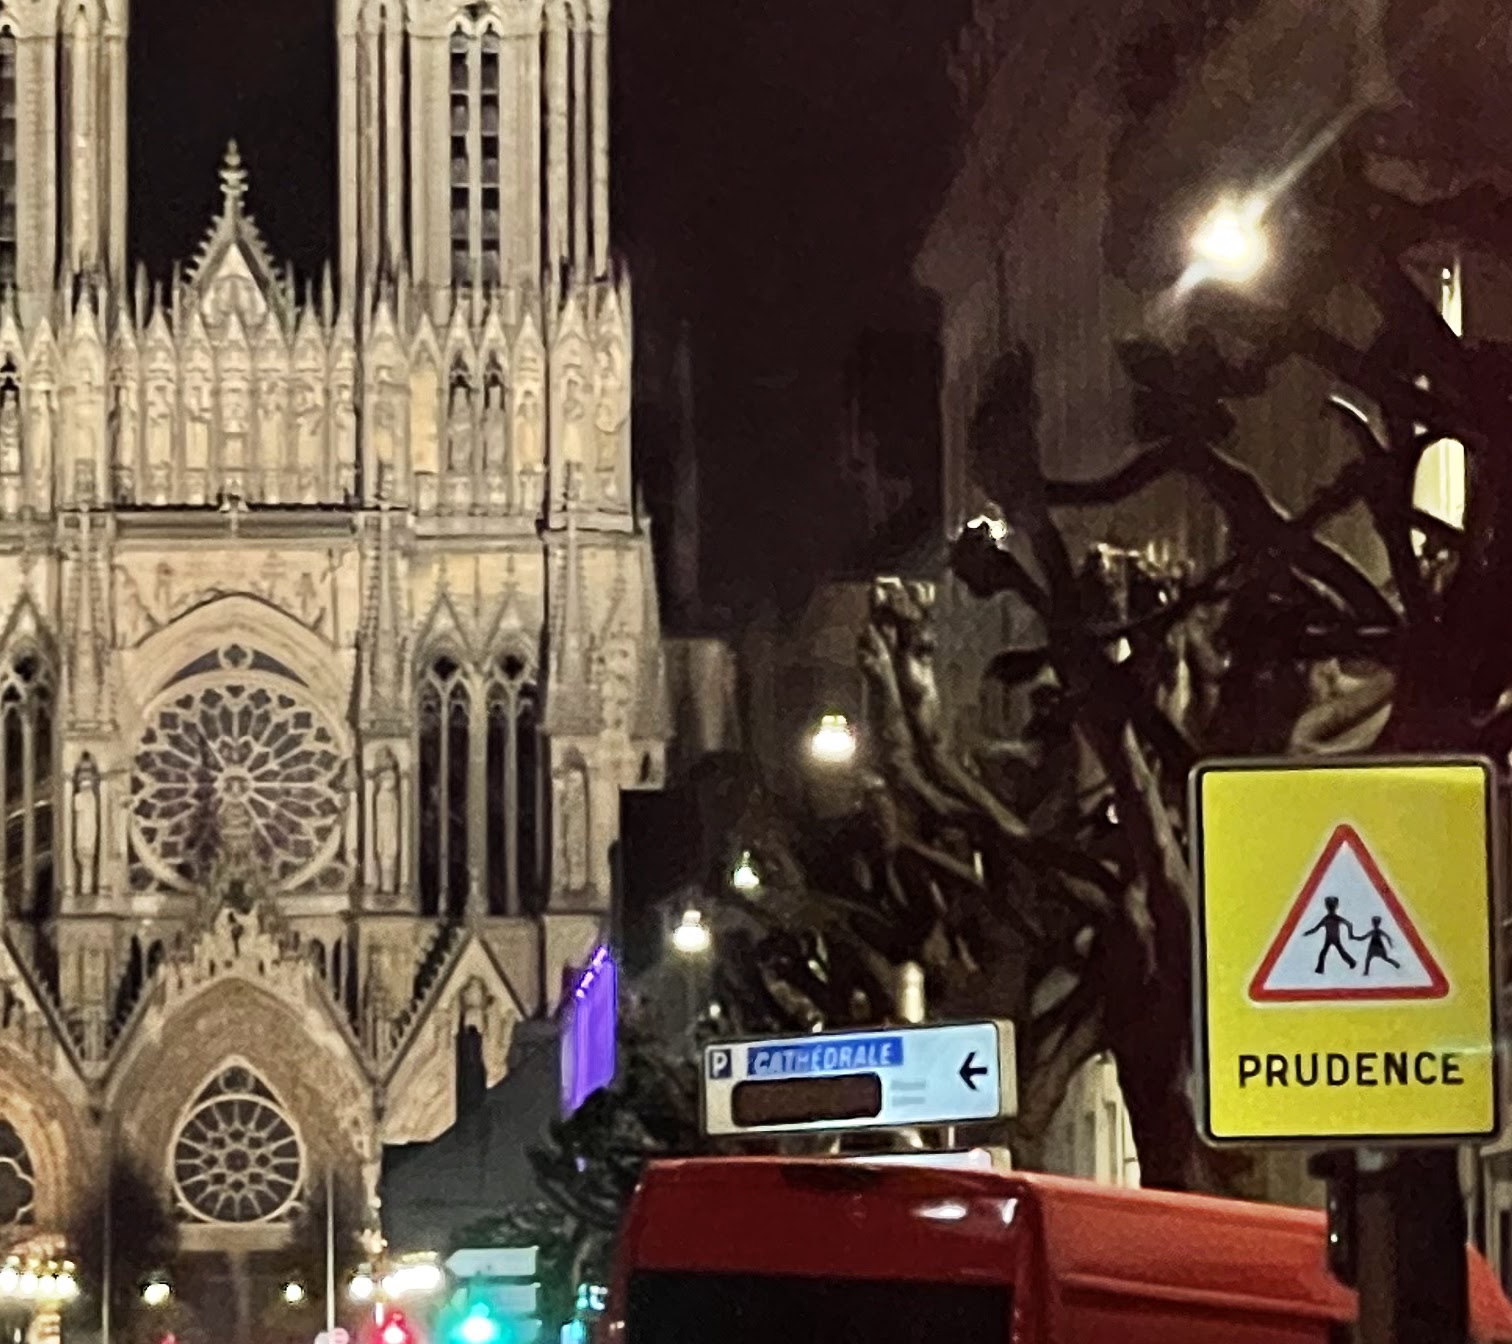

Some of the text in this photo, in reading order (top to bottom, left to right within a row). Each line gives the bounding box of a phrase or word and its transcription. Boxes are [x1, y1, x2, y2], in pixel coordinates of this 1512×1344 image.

[711, 1042, 892, 1077] P CATHÉDRALE
[1238, 1051, 1465, 1088] PRUDENCE
